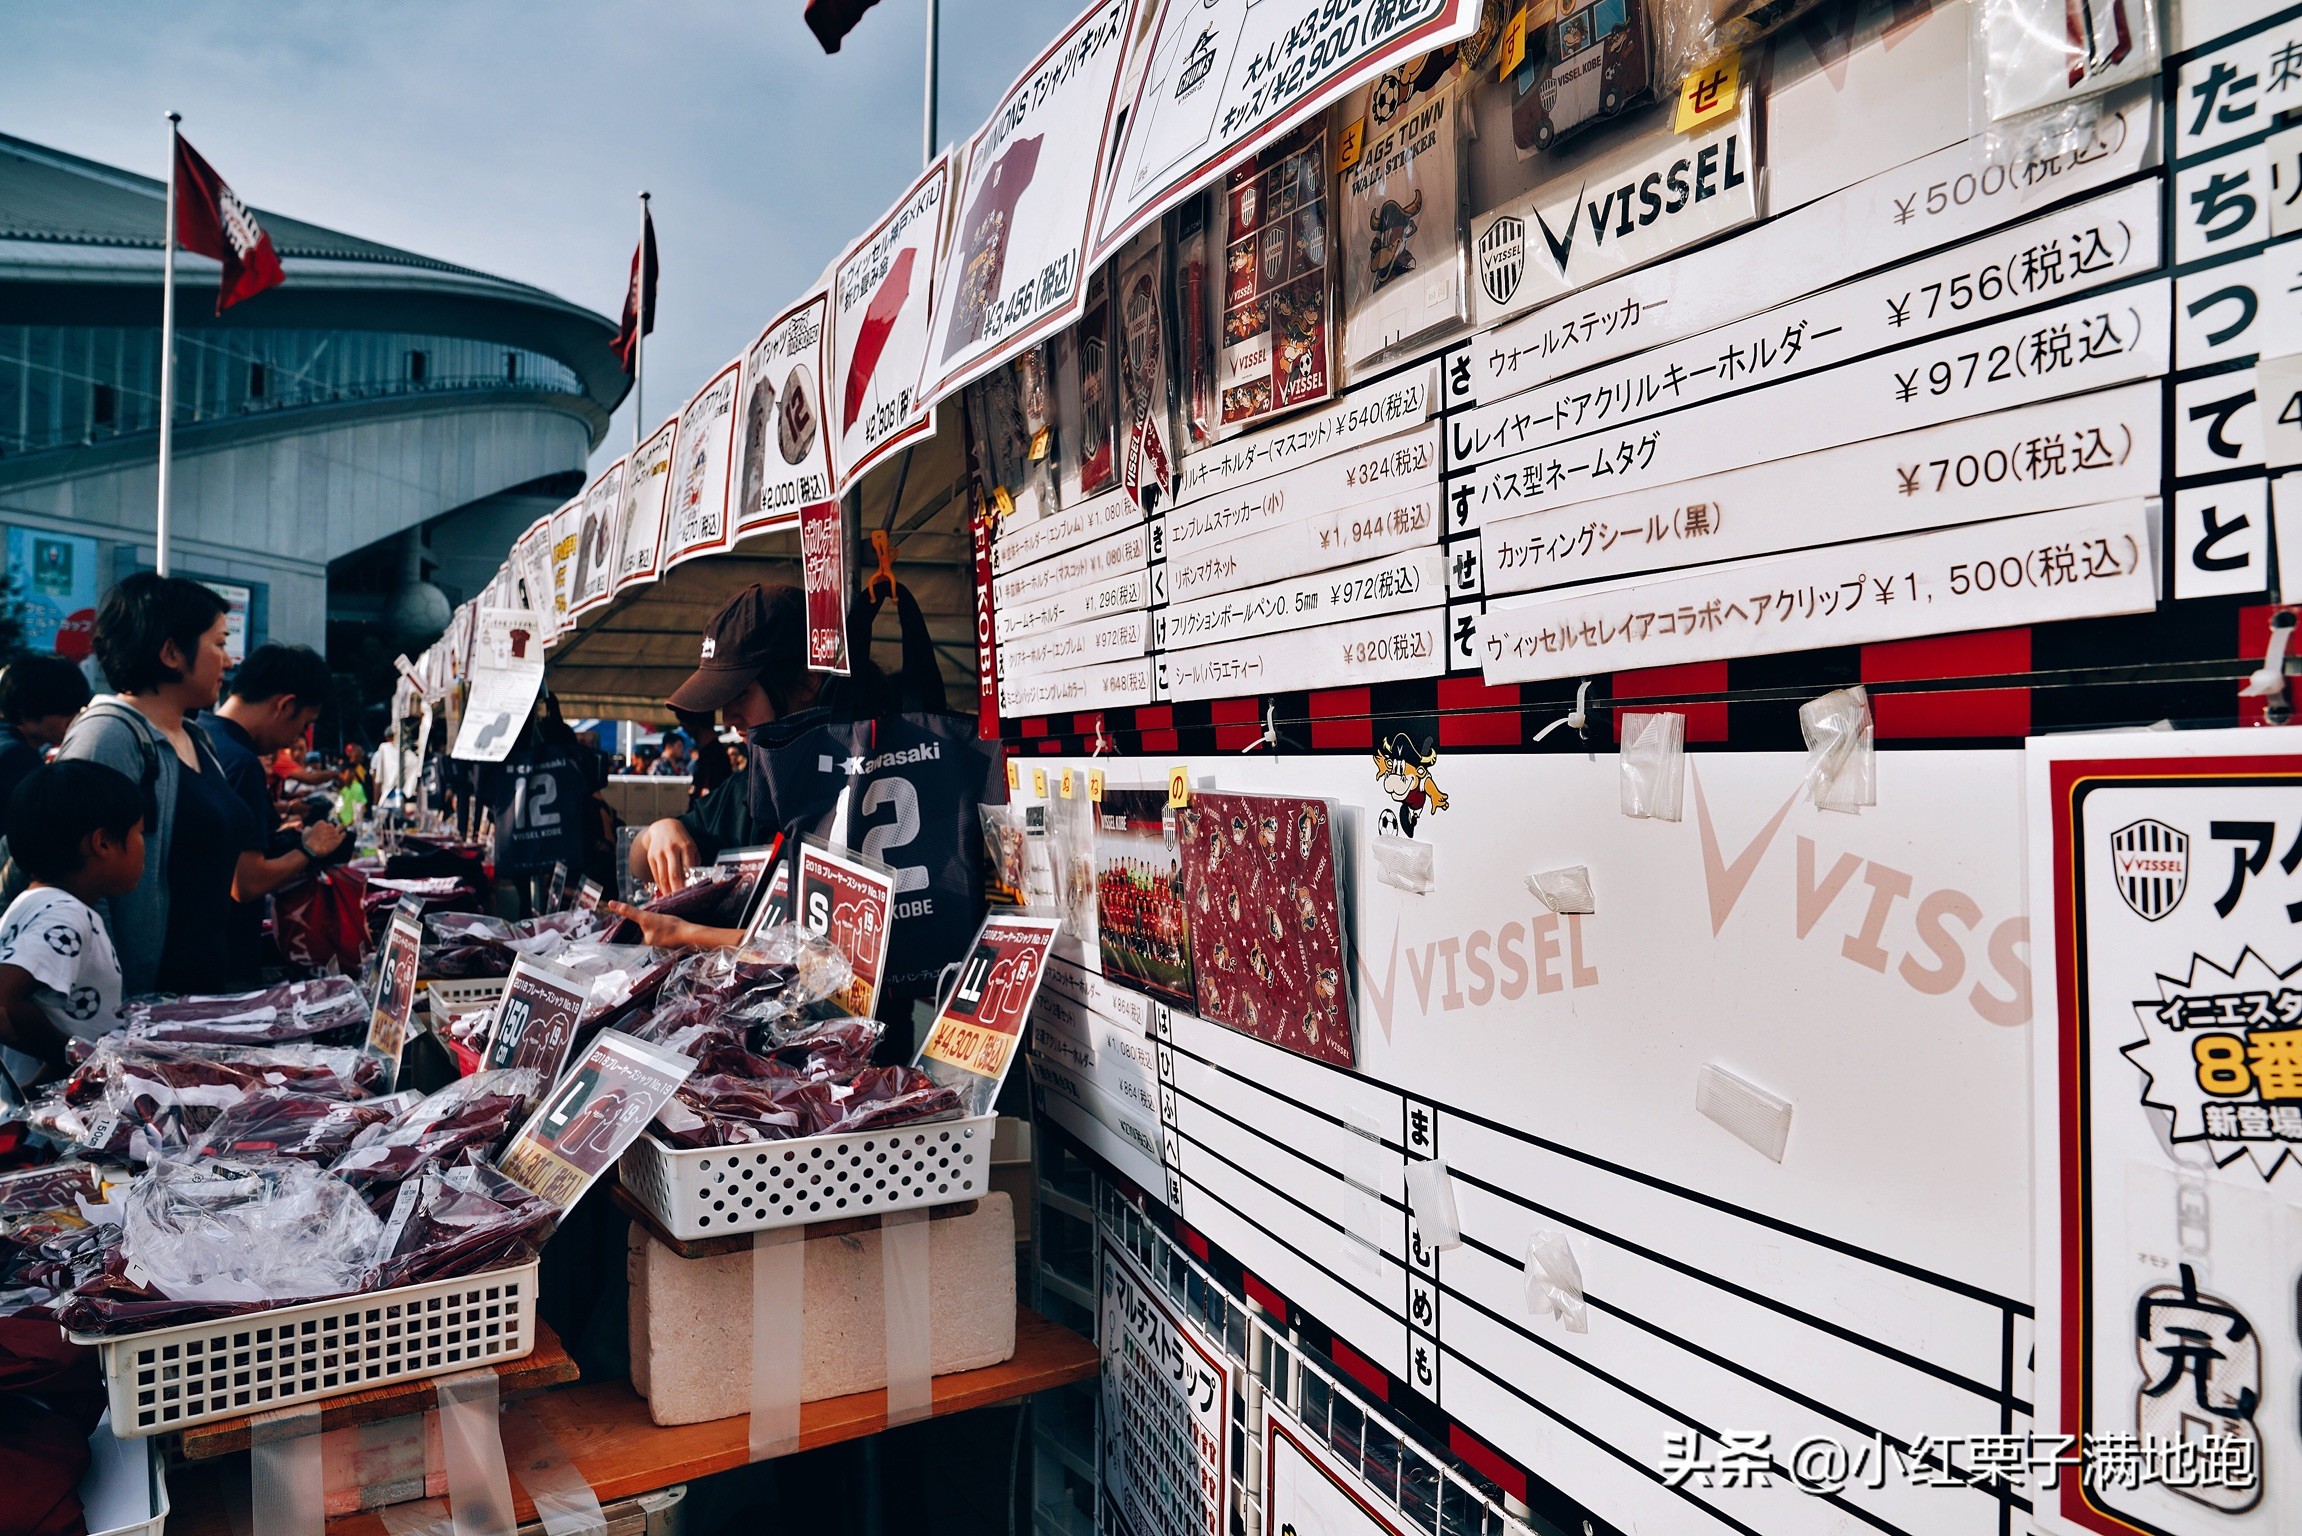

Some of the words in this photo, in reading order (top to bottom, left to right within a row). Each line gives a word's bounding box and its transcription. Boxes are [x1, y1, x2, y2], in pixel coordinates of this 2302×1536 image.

[1557, 66, 1582, 88] VISSEL
[1582, 54, 1602, 76] KOBE
[1689, 69, 1729, 115] せ
[2187, 62, 2259, 136] た
[1397, 97, 1447, 147] TOWN
[1351, 167, 1383, 198] WALL
[1385, 129, 1438, 174] STICKER
[1587, 133, 1746, 248] VISSEL
[2190, 169, 2257, 243] ち
[1493, 243, 1522, 264] VISSEL
[844, 255, 890, 314] 折り畳み傘
[1474, 321, 1844, 453] レイヤードアクリルキーホルダー
[1886, 220, 2132, 328] ¥756(税込)
[1489, 297, 1669, 378] ウォールステッカー
[2186, 284, 2259, 347] つ
[1238, 348, 1267, 371] VISSEL
[1449, 355, 1472, 398] さ
[1290, 371, 1324, 394] VISSEL
[1335, 382, 1425, 435] ¥540(税込)
[1481, 430, 1662, 505] バス型ネームタグ
[1894, 307, 2142, 403] ¥972(税込)
[2187, 388, 2257, 459] て
[1127, 433, 1141, 488] VISSEL
[1135, 386, 1150, 430] KOBE
[1452, 421, 1475, 461] し
[1172, 490, 1285, 543] エンブレムステッカー(小)
[1346, 441, 1435, 488] ¥324(税込)
[1451, 482, 1476, 527] す
[1497, 500, 1722, 571] カッティングシール(黒)
[1896, 422, 2133, 497] ¥700(税込)
[1152, 526, 1163, 554] き
[2192, 505, 2251, 573] と
[1155, 570, 1165, 599] く
[1175, 555, 1237, 589] リボンマグネット
[1330, 564, 1420, 605] ¥972(税込)
[1452, 549, 1478, 589] せ
[977, 584, 993, 697] KOBE
[1095, 624, 1141, 647] ¥972(税込)
[1175, 656, 1264, 686] シール(バラエティー)
[1342, 630, 1434, 664] ¥320(税込)
[1453, 615, 1478, 658] そ
[851, 742, 941, 776] Kawasaki
[514, 772, 561, 829] 12
[1172, 775, 1184, 801] の
[2135, 857, 2183, 873] VISSEL
[808, 891, 829, 936] S
[864, 911, 874, 932] 19
[383, 958, 395, 996] S
[957, 957, 989, 1004] LL
[1016, 960, 1030, 981] 19
[1405, 912, 1599, 1018] VISSEL
[499, 998, 531, 1049] 150
[550, 1024, 562, 1046] 19
[549, 1080, 586, 1127] L
[619, 1102, 640, 1124] 19
[88, 1119, 110, 1148] 150cm
[1411, 1108, 1430, 1147] ま
[1413, 1288, 1434, 1328] め
[1114, 1269, 1217, 1414] マルチストラップ
[2136, 1262, 2258, 1418] 完
[1414, 1346, 1433, 1387] も
